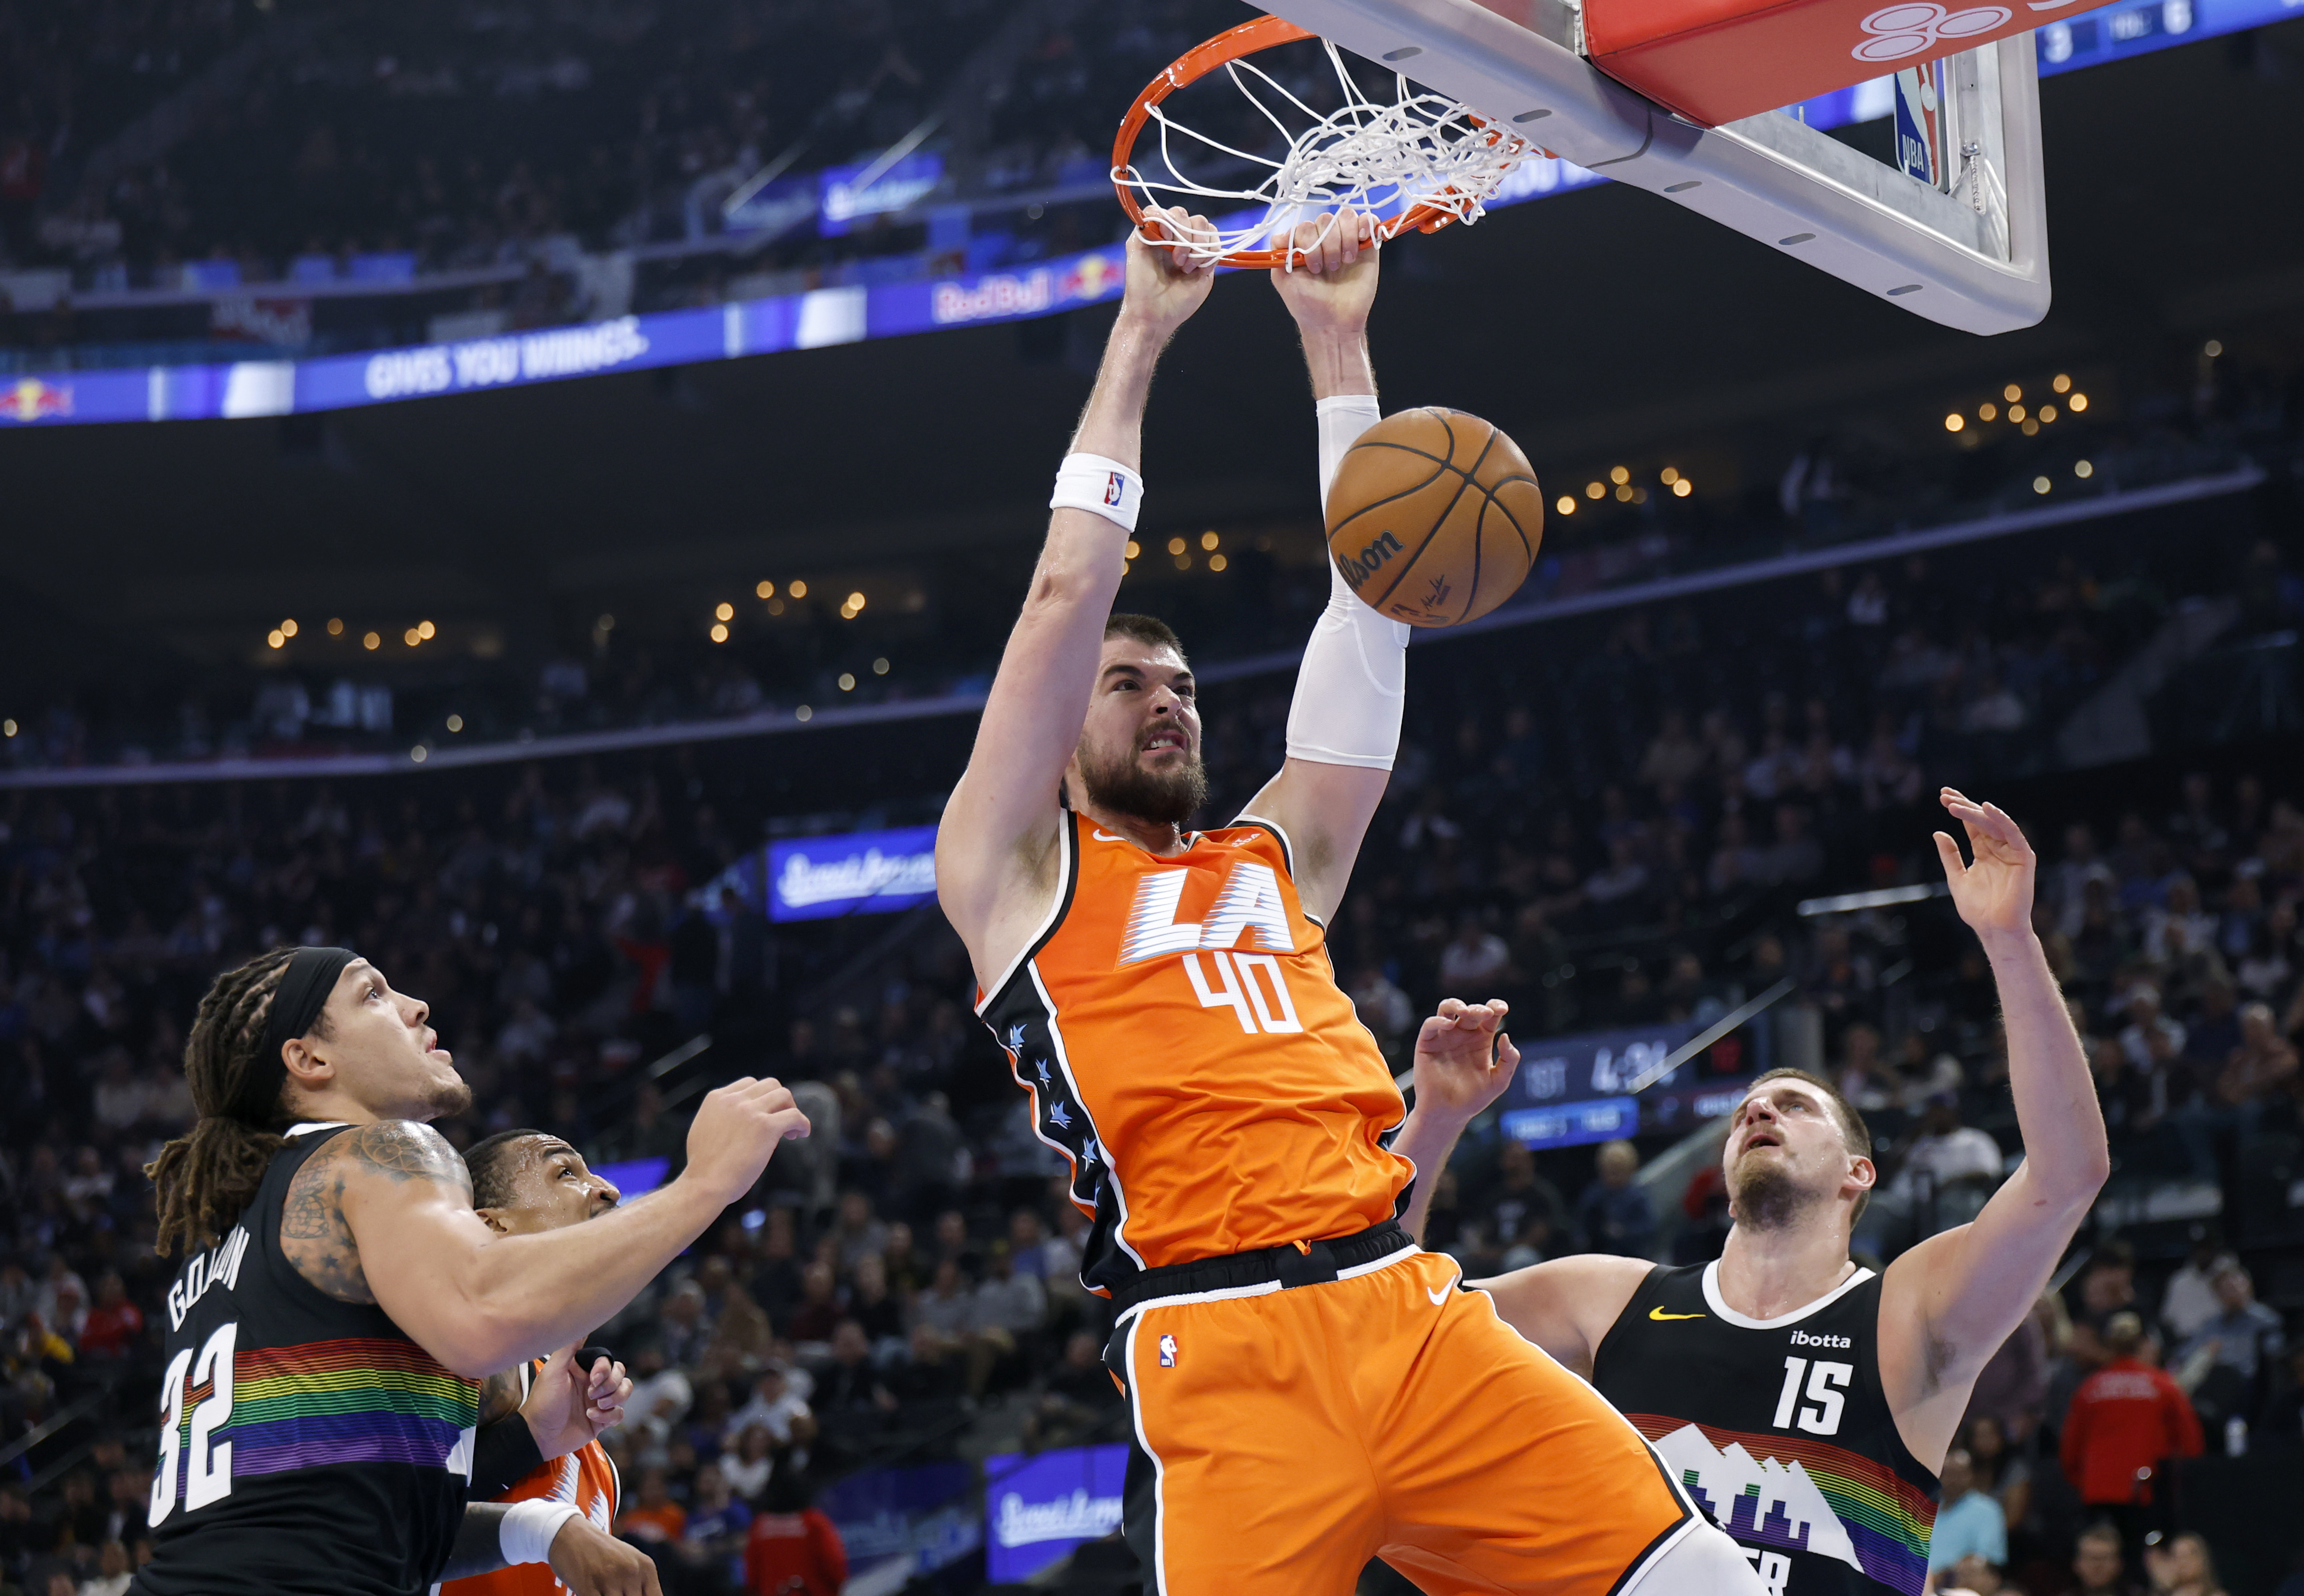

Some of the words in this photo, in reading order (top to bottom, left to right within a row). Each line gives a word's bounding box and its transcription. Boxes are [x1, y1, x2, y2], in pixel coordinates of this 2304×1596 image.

[1902, 134, 1925, 172] NBA
[934, 281, 995, 324] Red
[993, 268, 1051, 316] Bull
[366, 345, 452, 399] GIVES
[453, 336, 517, 387] YOU
[1118, 862, 1295, 966] LA
[1182, 951, 1304, 1034] 40
[1790, 1330, 1851, 1349] ibotta
[147, 1322, 237, 1528] 32
[1773, 1355, 1854, 1436] 15
